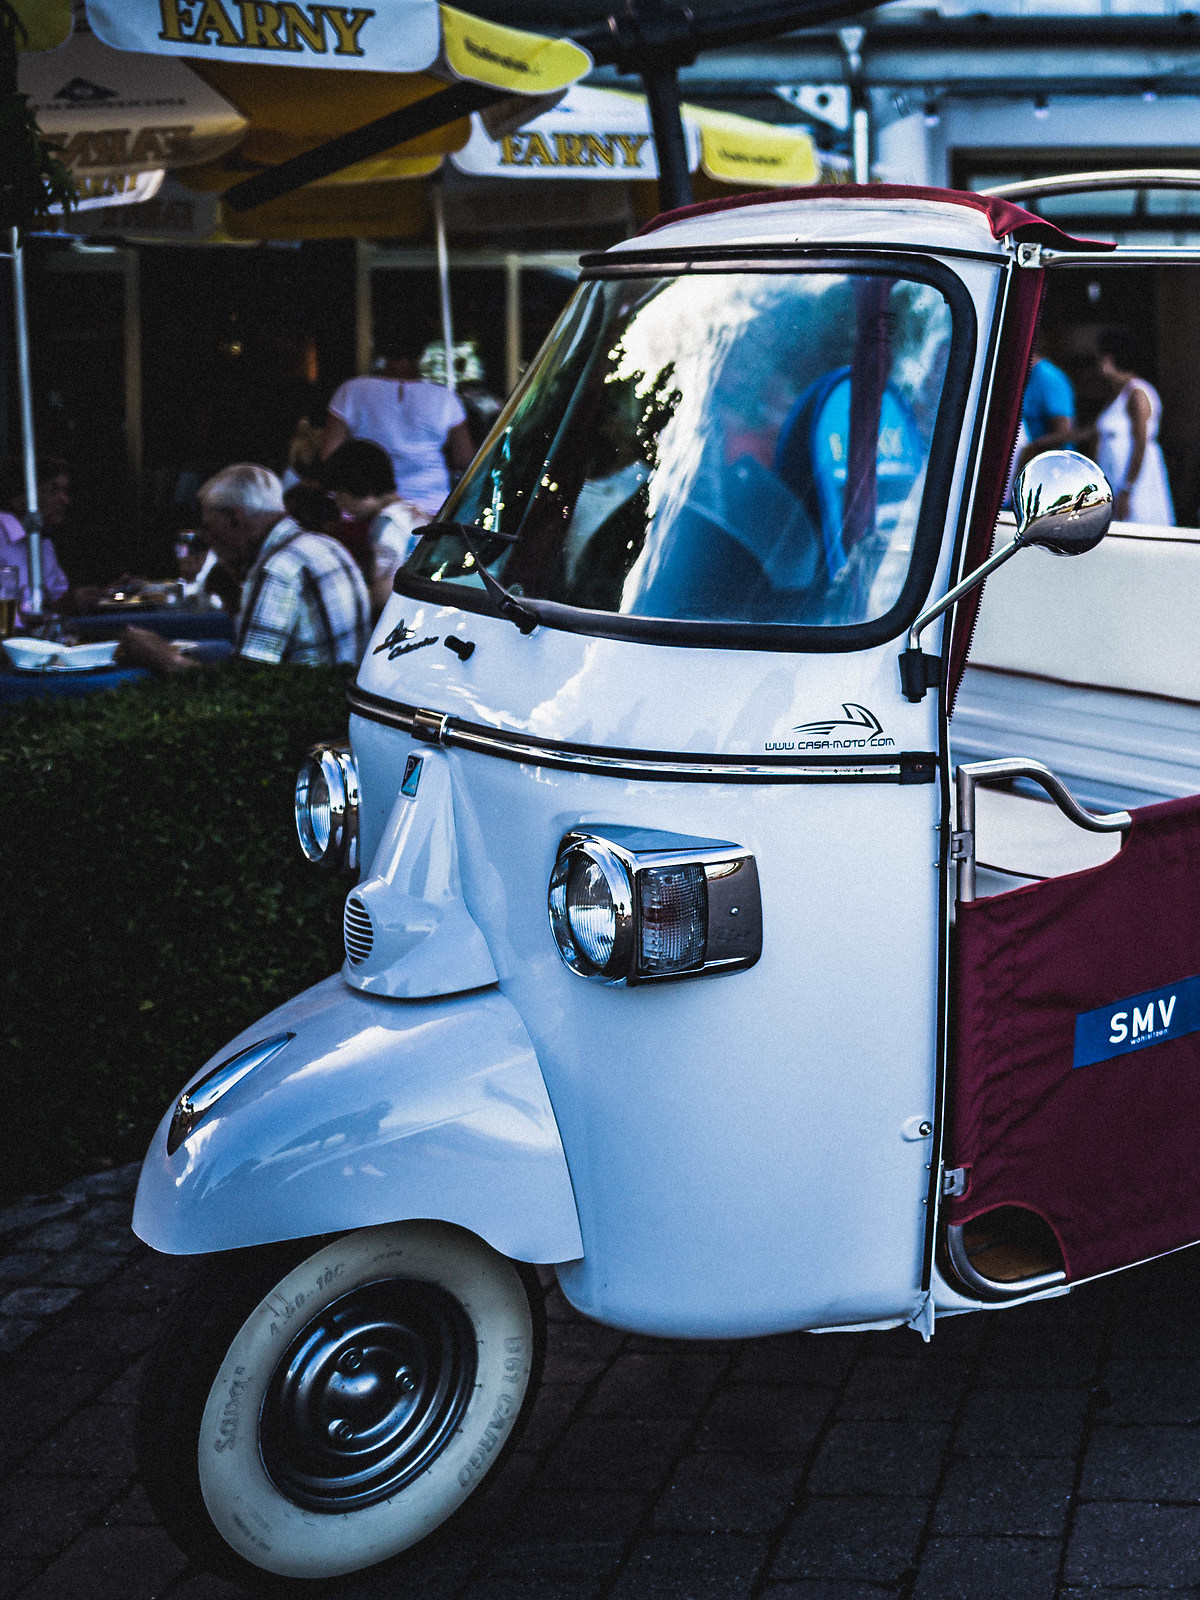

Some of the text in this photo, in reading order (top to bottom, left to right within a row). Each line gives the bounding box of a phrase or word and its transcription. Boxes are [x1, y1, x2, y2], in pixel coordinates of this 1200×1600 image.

[158, 0, 376, 57] FARNY
[499, 131, 649, 168] FARNY
[1109, 995, 1176, 1043] SMV
